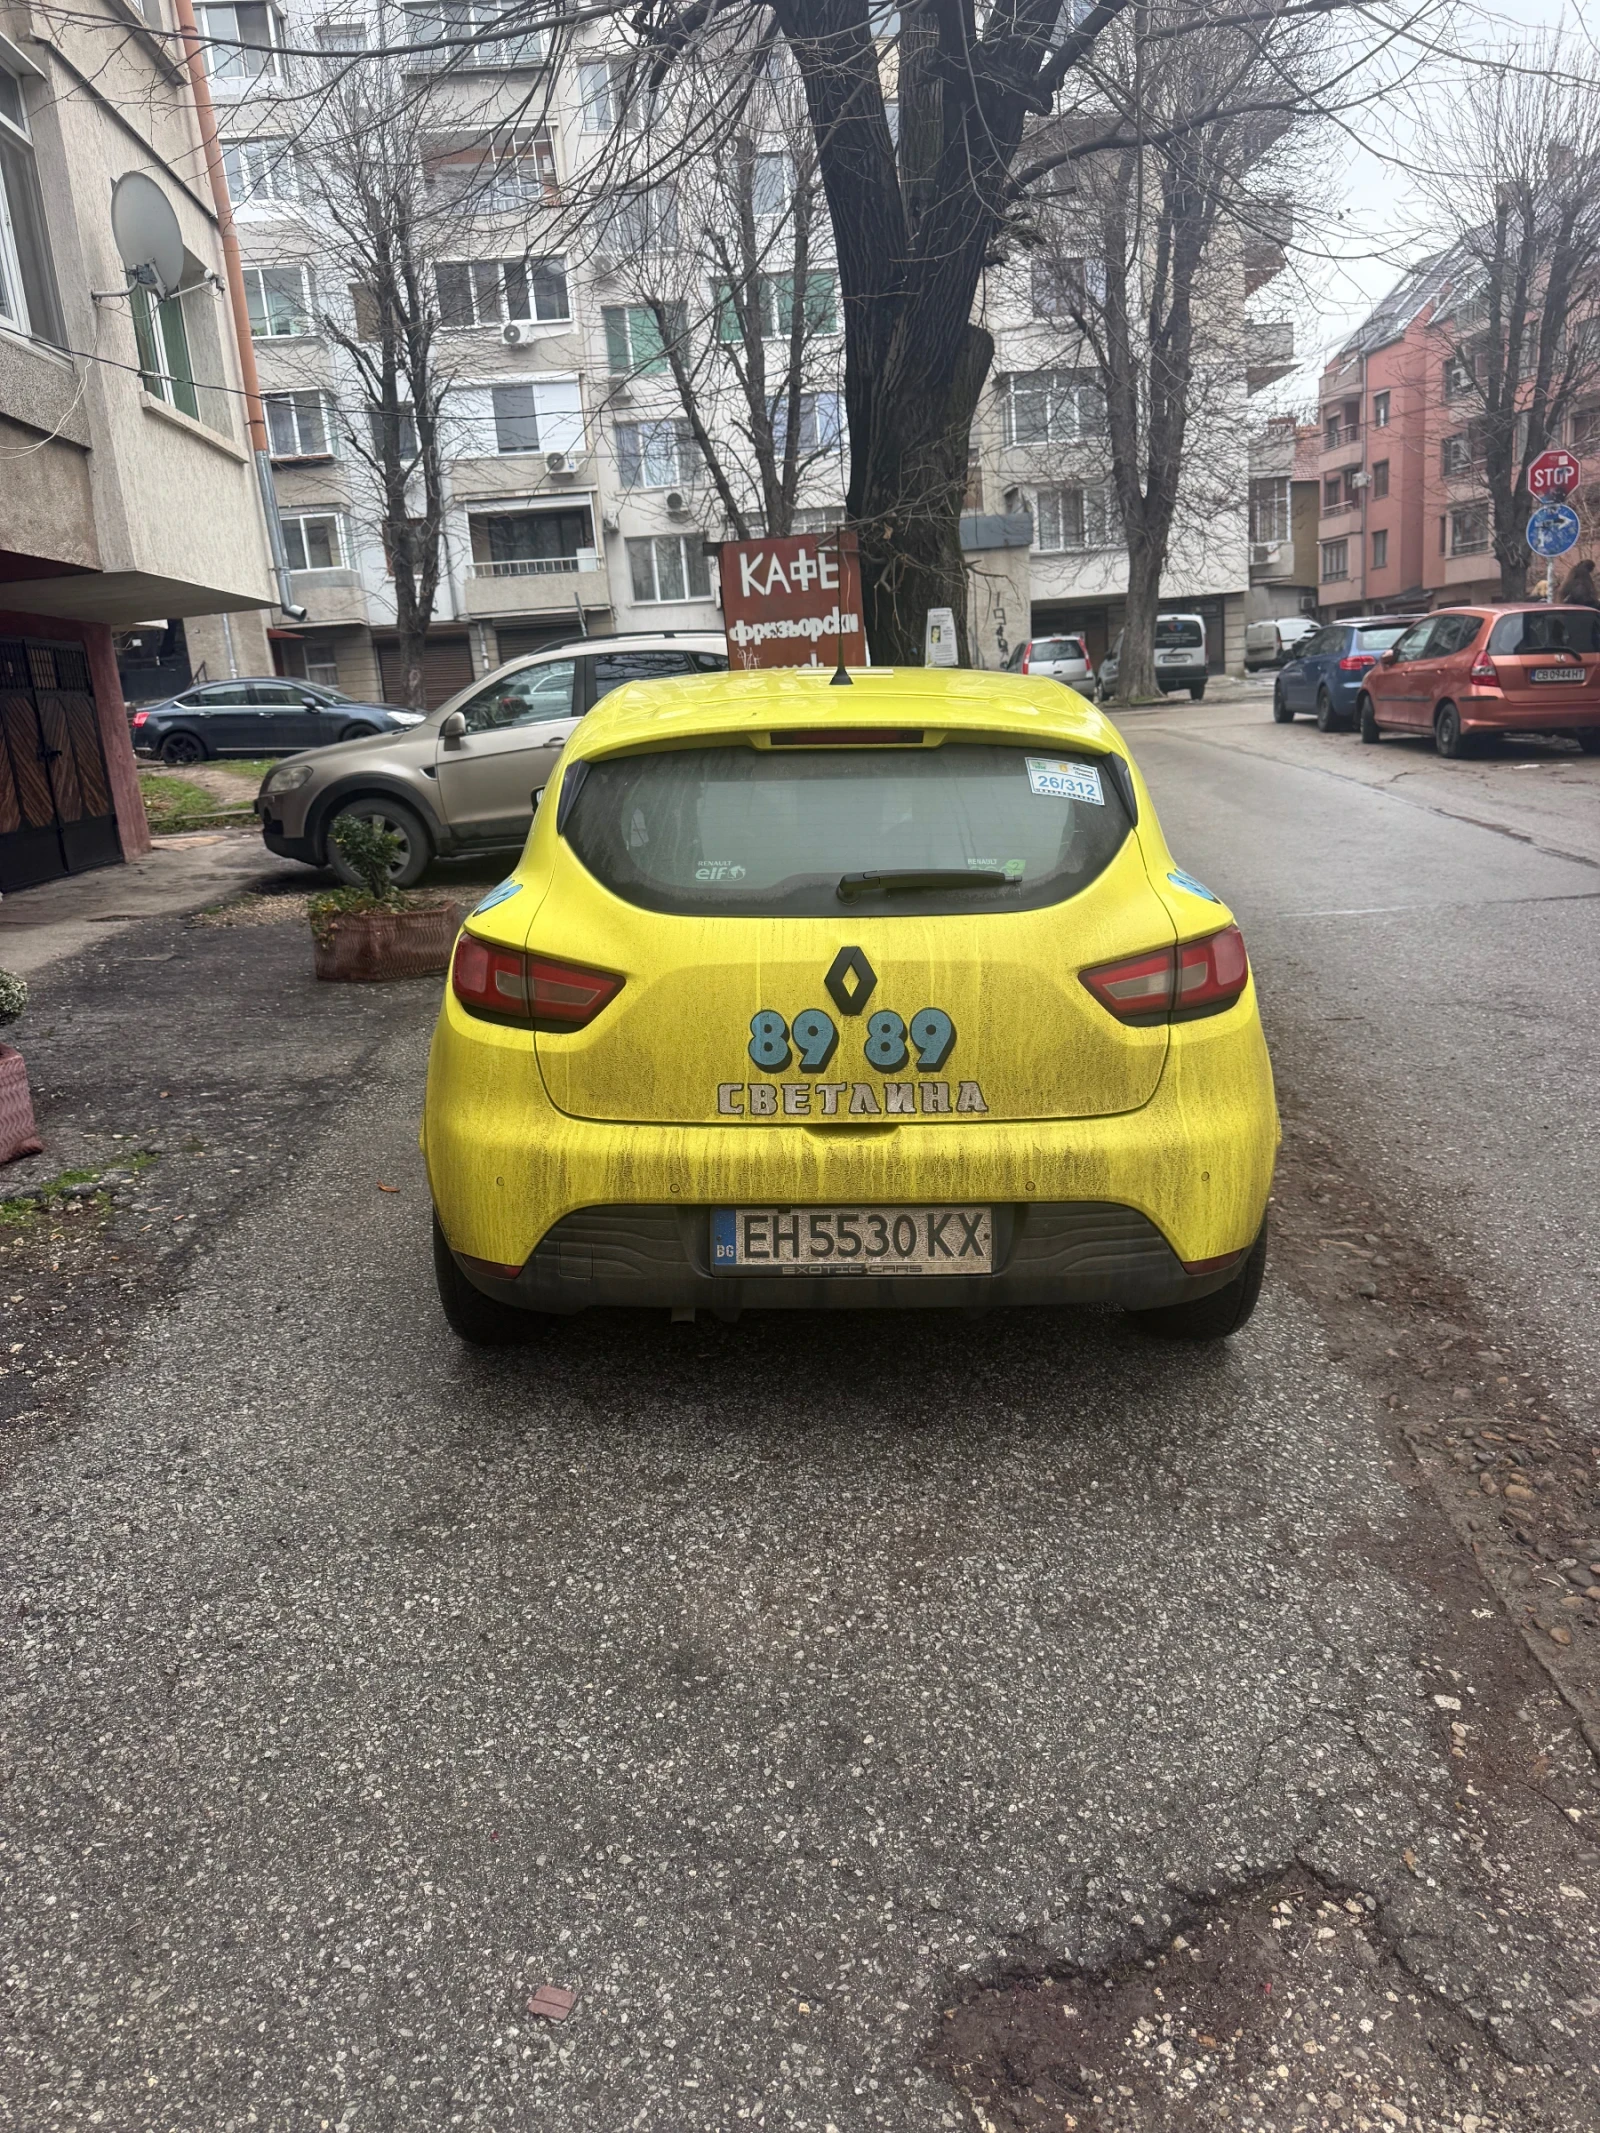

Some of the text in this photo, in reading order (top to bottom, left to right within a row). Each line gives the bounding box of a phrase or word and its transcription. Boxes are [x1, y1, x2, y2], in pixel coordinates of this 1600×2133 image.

[1534, 466, 1574, 487] STOP
[739, 545, 839, 597] КАФЕ
[1037, 775, 1097, 797] 26/312
[695, 867, 728, 880] elf
[748, 1007, 957, 1074] 89 89
[717, 1080, 989, 1115] СВЕТЛИНА
[716, 1244, 734, 1258] BG
[782, 1265, 922, 1275] EXOTIC CARS
